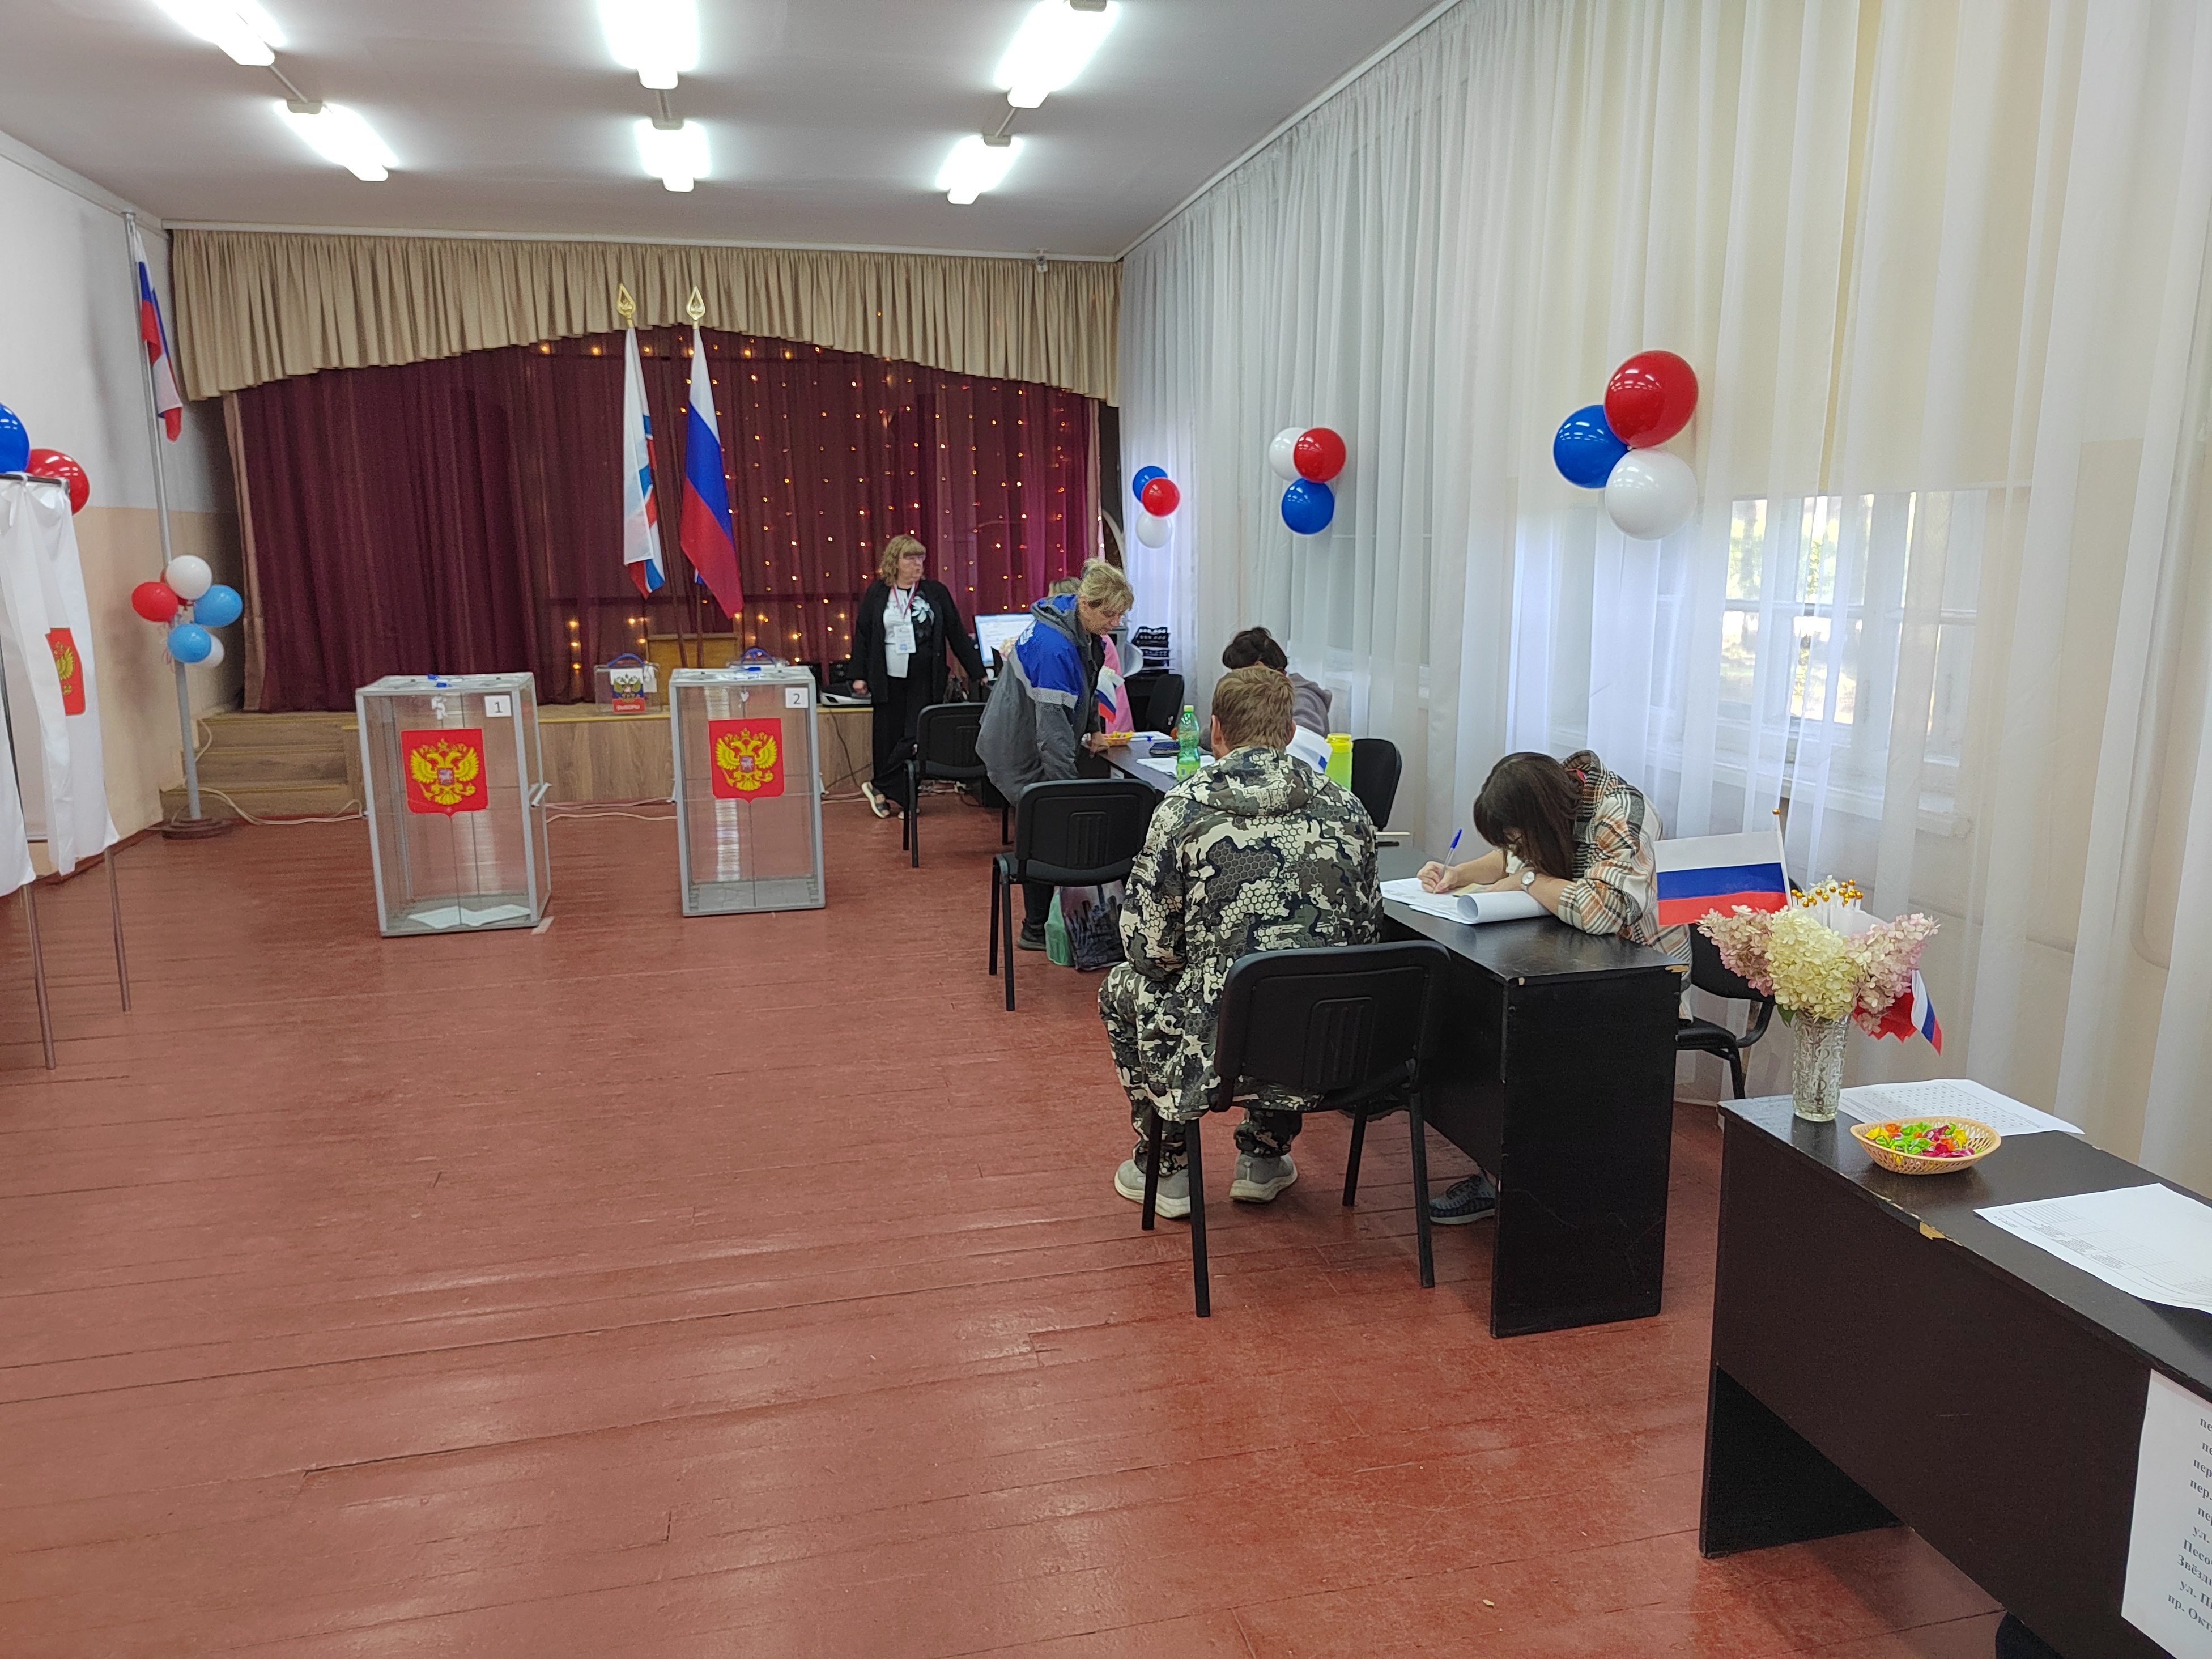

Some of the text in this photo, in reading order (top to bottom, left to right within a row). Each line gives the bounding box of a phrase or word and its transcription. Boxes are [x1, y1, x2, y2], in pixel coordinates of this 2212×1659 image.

[494, 701, 503, 713] 1
[793, 692, 801, 705] 2
[2197, 1507, 2212, 1526] пе
[2192, 1526, 2210, 1543] ул.
[2183, 1538, 2212, 1565] Песо
[2179, 1580, 2197, 1598] ул.
[2168, 1594, 2212, 1632] пр. Окт
